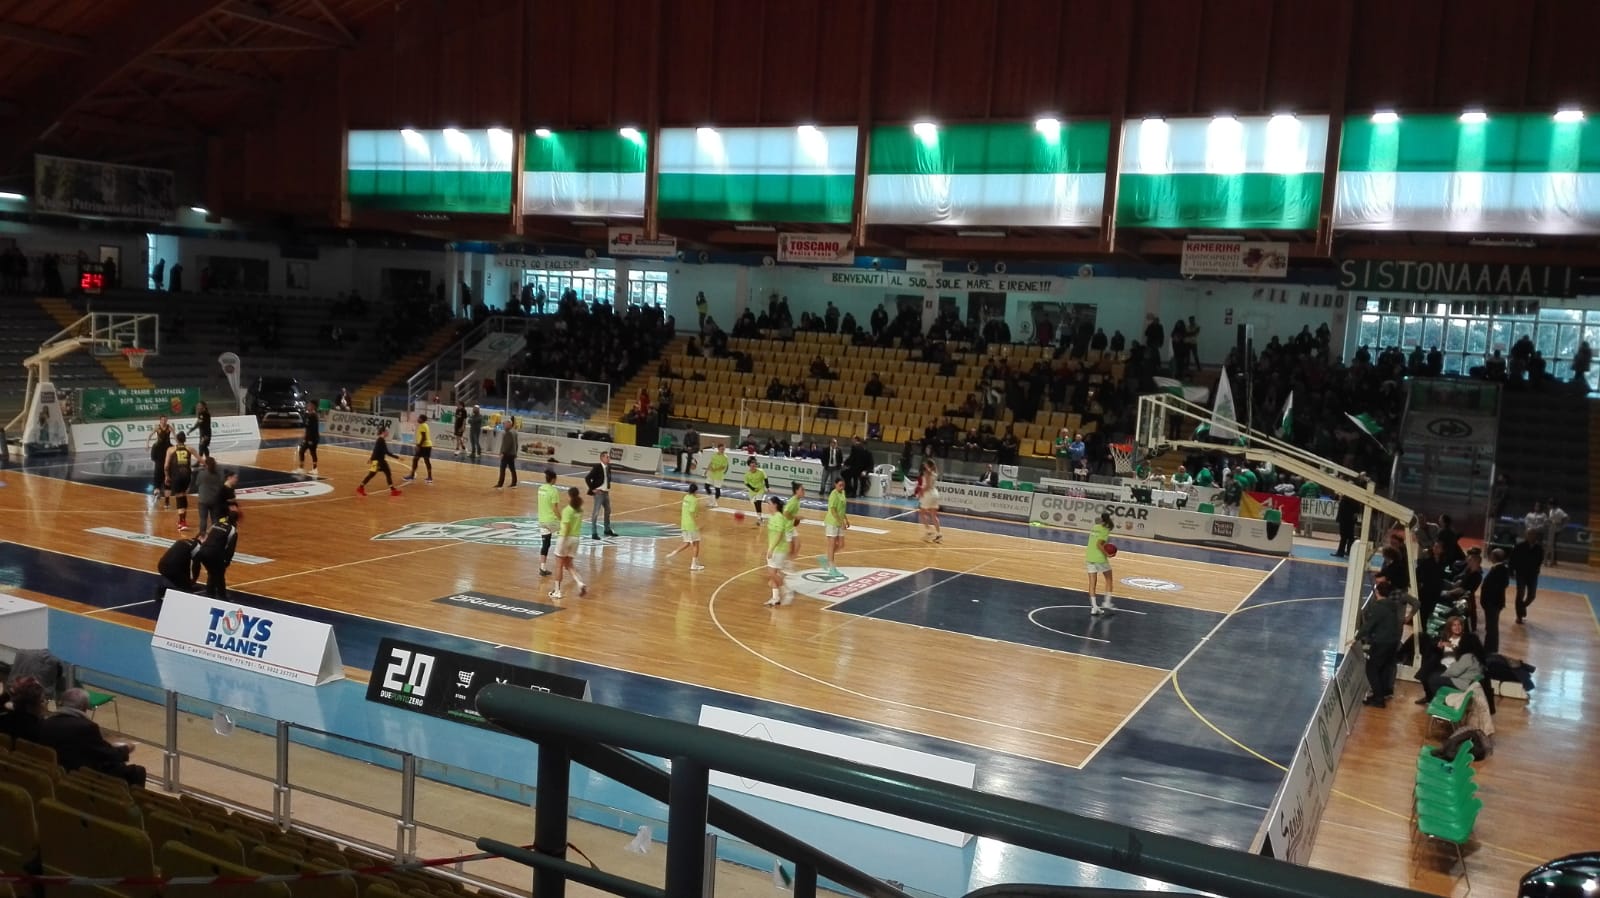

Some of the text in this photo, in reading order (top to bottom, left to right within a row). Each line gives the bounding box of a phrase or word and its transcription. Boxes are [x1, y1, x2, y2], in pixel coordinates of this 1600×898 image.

[790, 240, 840, 252] TOSCANO
[81, 273, 102, 288] 24
[832, 272, 883, 284] BENVENUTI
[891, 276, 902, 285] AL
[1300, 291, 1344, 308] NIDO
[176, 450, 188, 461] 12
[732, 457, 813, 475] Pasalacqua
[935, 485, 1030, 503] NUOVA AVIR SERVICE
[1042, 497, 1149, 520] GRUPPOSCAR
[209, 607, 273, 642] TOYS
[205, 631, 268, 659] PLANET
[383, 647, 435, 697] 2.0
